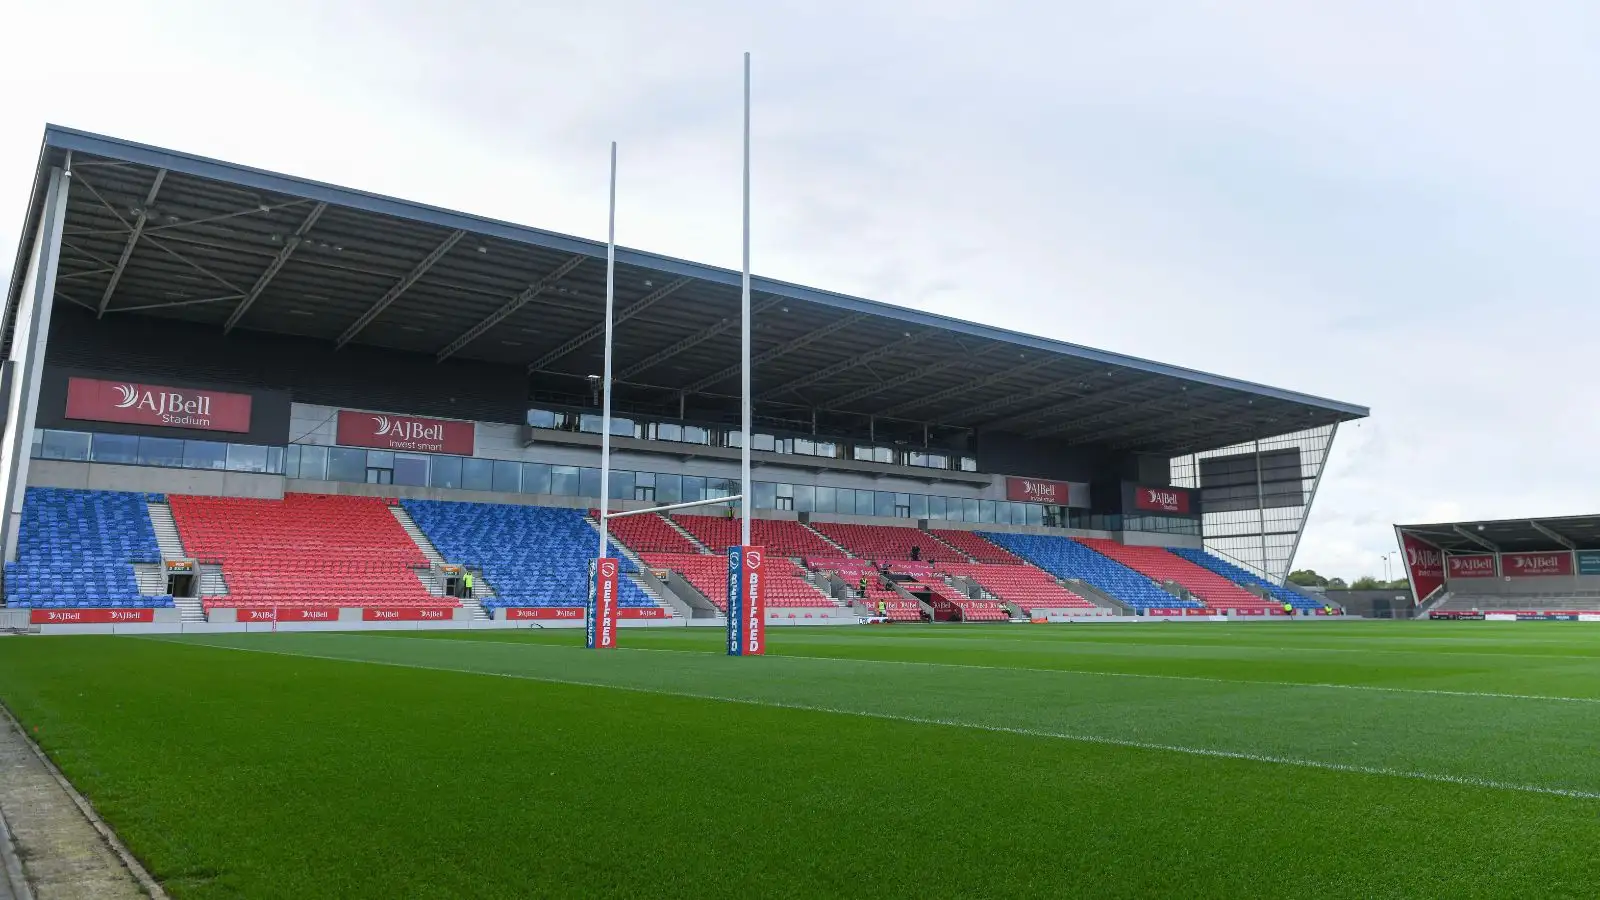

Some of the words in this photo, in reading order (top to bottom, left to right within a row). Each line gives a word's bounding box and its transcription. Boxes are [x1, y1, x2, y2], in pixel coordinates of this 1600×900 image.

[138, 391, 211, 416] AJBell
[163, 413, 210, 427] Stadium
[390, 421, 444, 441] AJBell
[389, 440, 415, 450] Invest
[417, 442, 442, 452] smart
[1031, 483, 1056, 497] AJBell
[1155, 492, 1178, 506] AJBell
[1524, 556, 1558, 569] AJBell
[56, 612, 81, 620] AJBell
[117, 611, 141, 620] AJBell
[602, 581, 611, 646] BETFRED
[750, 573, 759, 652] BETFRED
